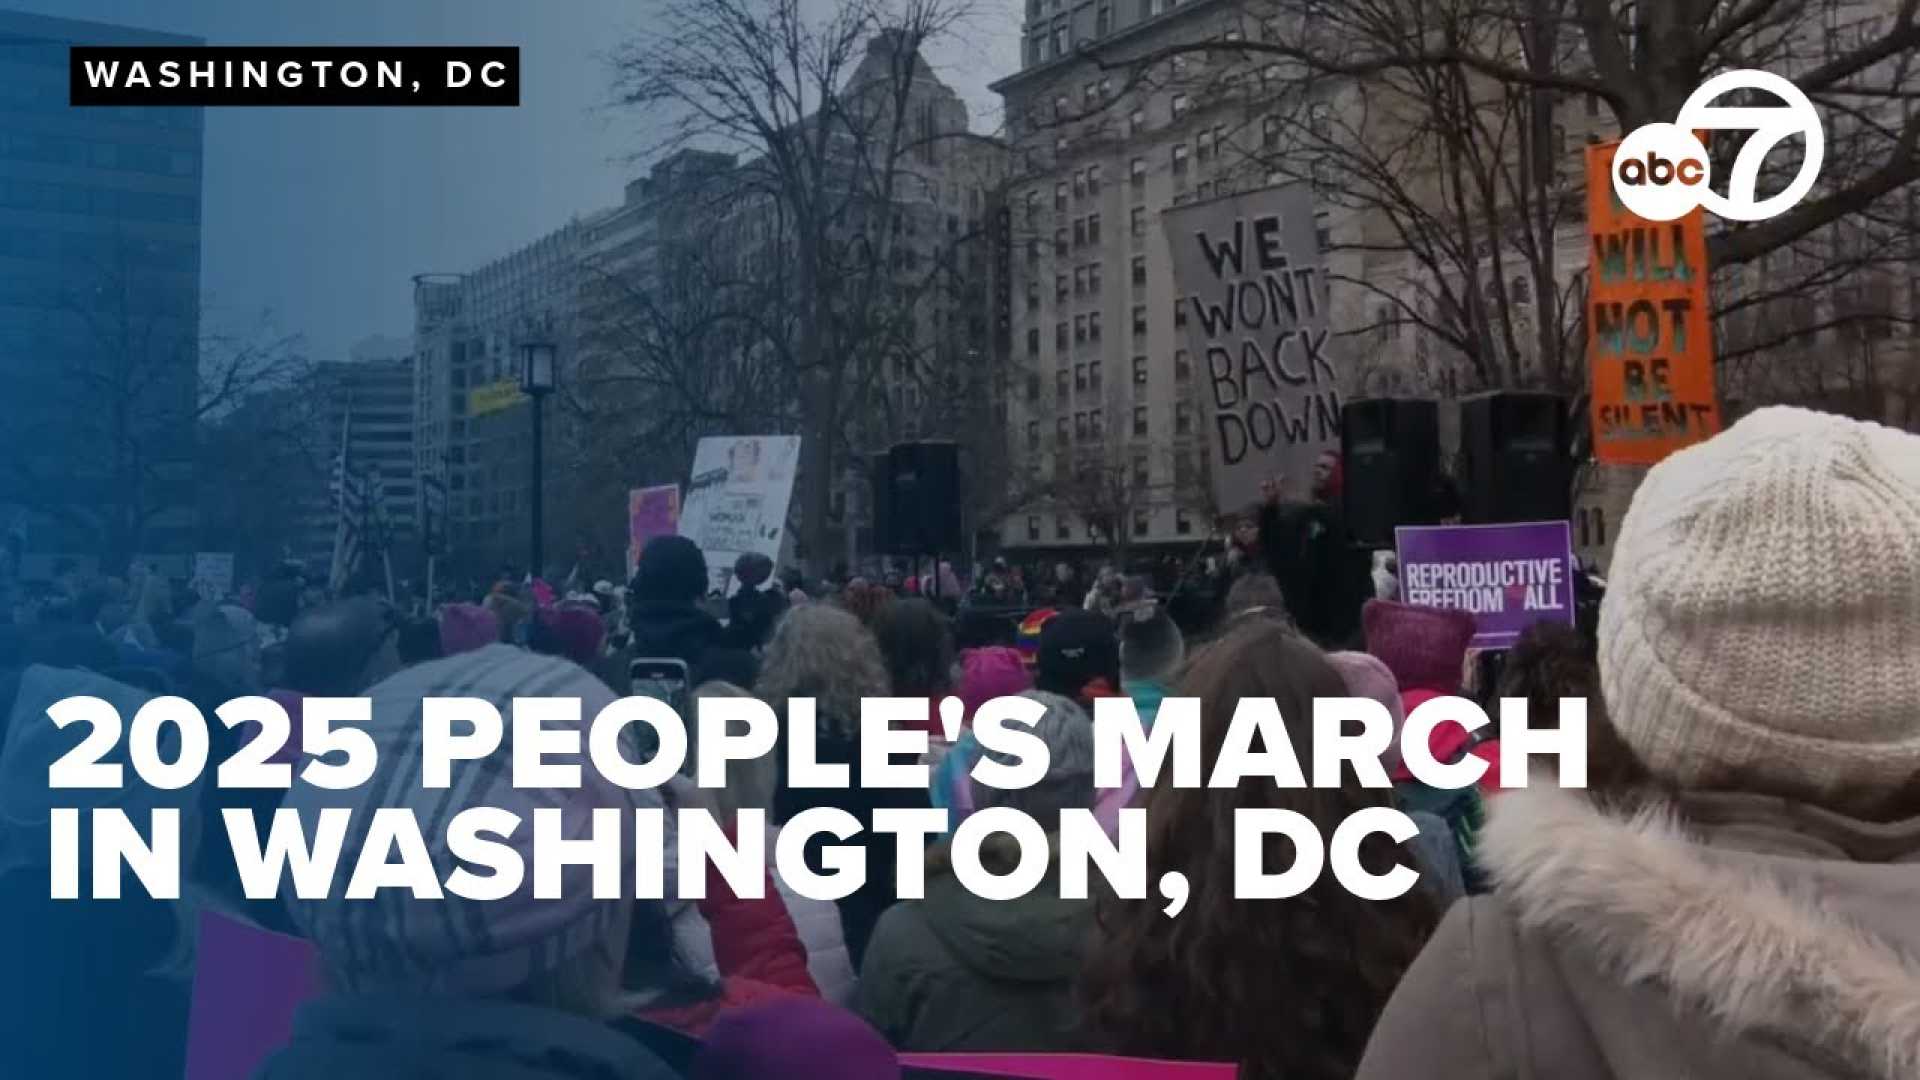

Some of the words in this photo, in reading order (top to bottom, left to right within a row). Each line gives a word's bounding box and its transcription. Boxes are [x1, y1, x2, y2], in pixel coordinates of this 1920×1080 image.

[1196, 216, 1288, 280] WE
[1593, 224, 1697, 283] WILL
[1191, 266, 1316, 338] WONT
[1594, 298, 1692, 355] NOT
[1206, 329, 1336, 410] BACK
[1622, 357, 1672, 400] BE
[1215, 390, 1343, 466] DOWN
[1599, 402, 1714, 440] SILENT
[1406, 557, 1563, 589] REPRODUCTIVE
[1408, 586, 1504, 613] FREEDOM
[1523, 585, 1564, 611] ALL
